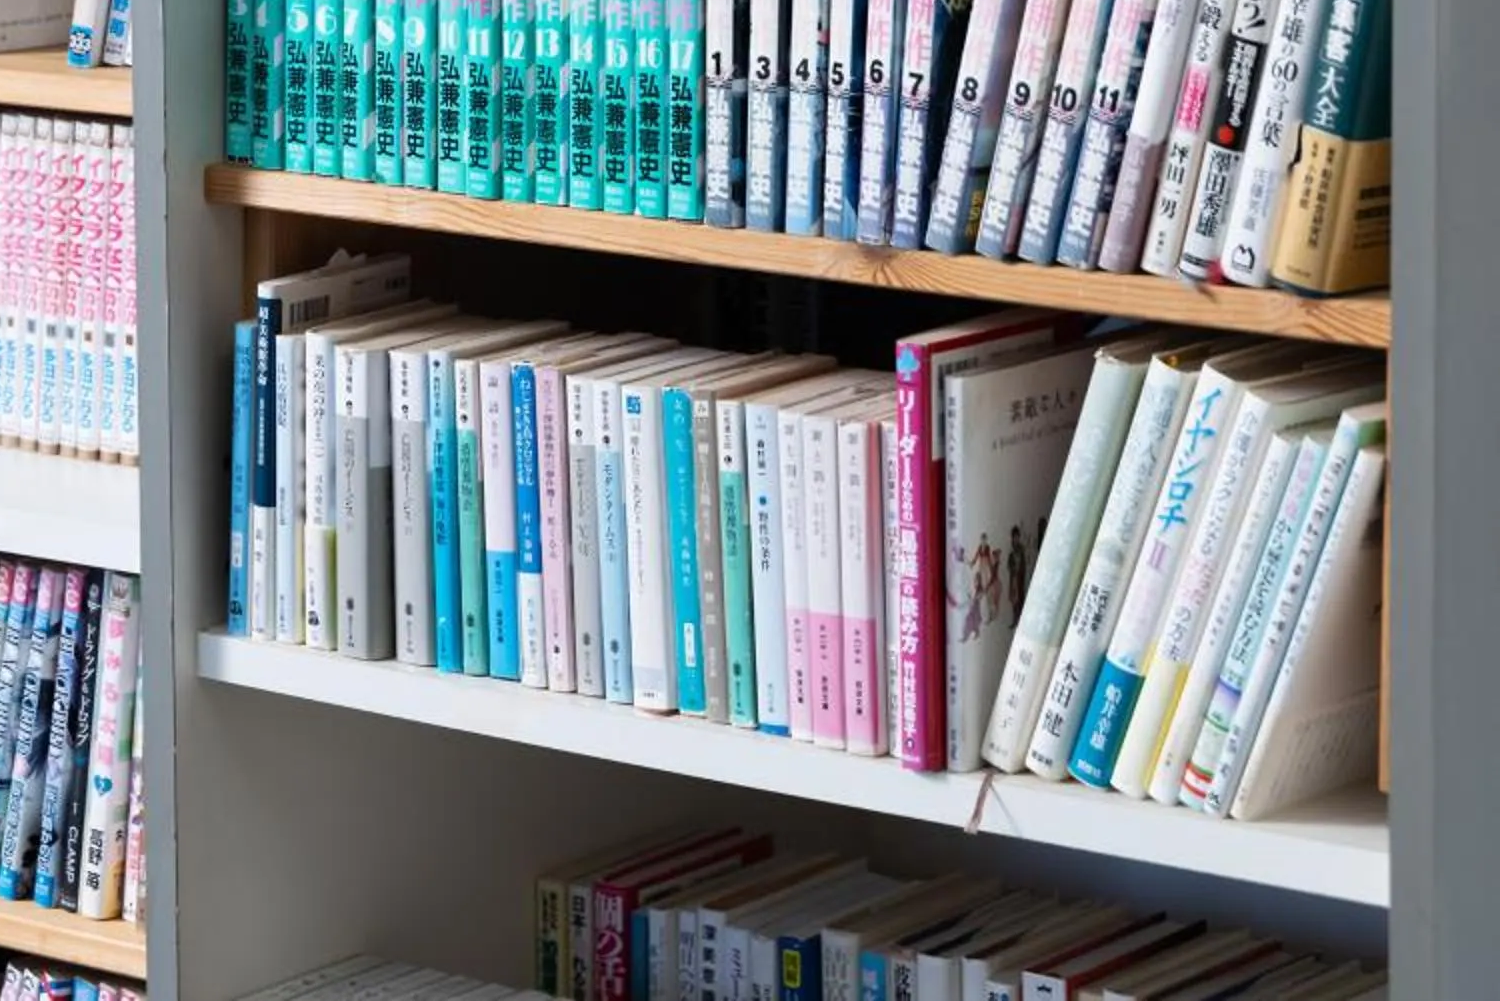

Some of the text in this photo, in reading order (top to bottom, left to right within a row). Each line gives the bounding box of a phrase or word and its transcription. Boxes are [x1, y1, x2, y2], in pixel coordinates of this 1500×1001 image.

[287, 6, 308, 32] 5
[316, 6, 337, 33] 6
[377, 16, 396, 43] 8
[406, 19, 425, 46] 9
[440, 21, 460, 49] 10
[469, 28, 489, 57] 11
[502, 30, 525, 59] 12
[536, 28, 558, 55] 13
[572, 33, 594, 63] 14
[606, 39, 627, 68] 15
[638, 39, 662, 68] 16
[670, 40, 693, 71] 17
[711, 52, 722, 76] 1
[755, 56, 771, 80] 3
[795, 58, 810, 82] 4
[831, 62, 845, 86] 5
[869, 60, 884, 84] 6
[287, 41, 307, 144] 弘兼憲史
[315, 41, 336, 144] 弘兼憲史
[908, 73, 924, 97] 7
[960, 77, 978, 101] 8
[1012, 82, 1031, 106] 9
[1051, 85, 1076, 111] 10
[1099, 87, 1121, 112] 11
[377, 52, 396, 157] 弘兼憲史
[406, 52, 426, 158] 弘兼憲史
[439, 55, 461, 162] 弘兼憲史
[469, 63, 489, 170] 弘兼憲史
[503, 64, 524, 174] 弘兼憲史
[536, 65, 558, 174] 弘兼憲史
[571, 69, 594, 177] 弘兼憲史
[605, 74, 626, 184] 弘兼憲史
[638, 73, 660, 183] 弘兼憲史
[670, 76, 692, 186] 弘兼憲史
[66, 826, 79, 884] CLAMP
